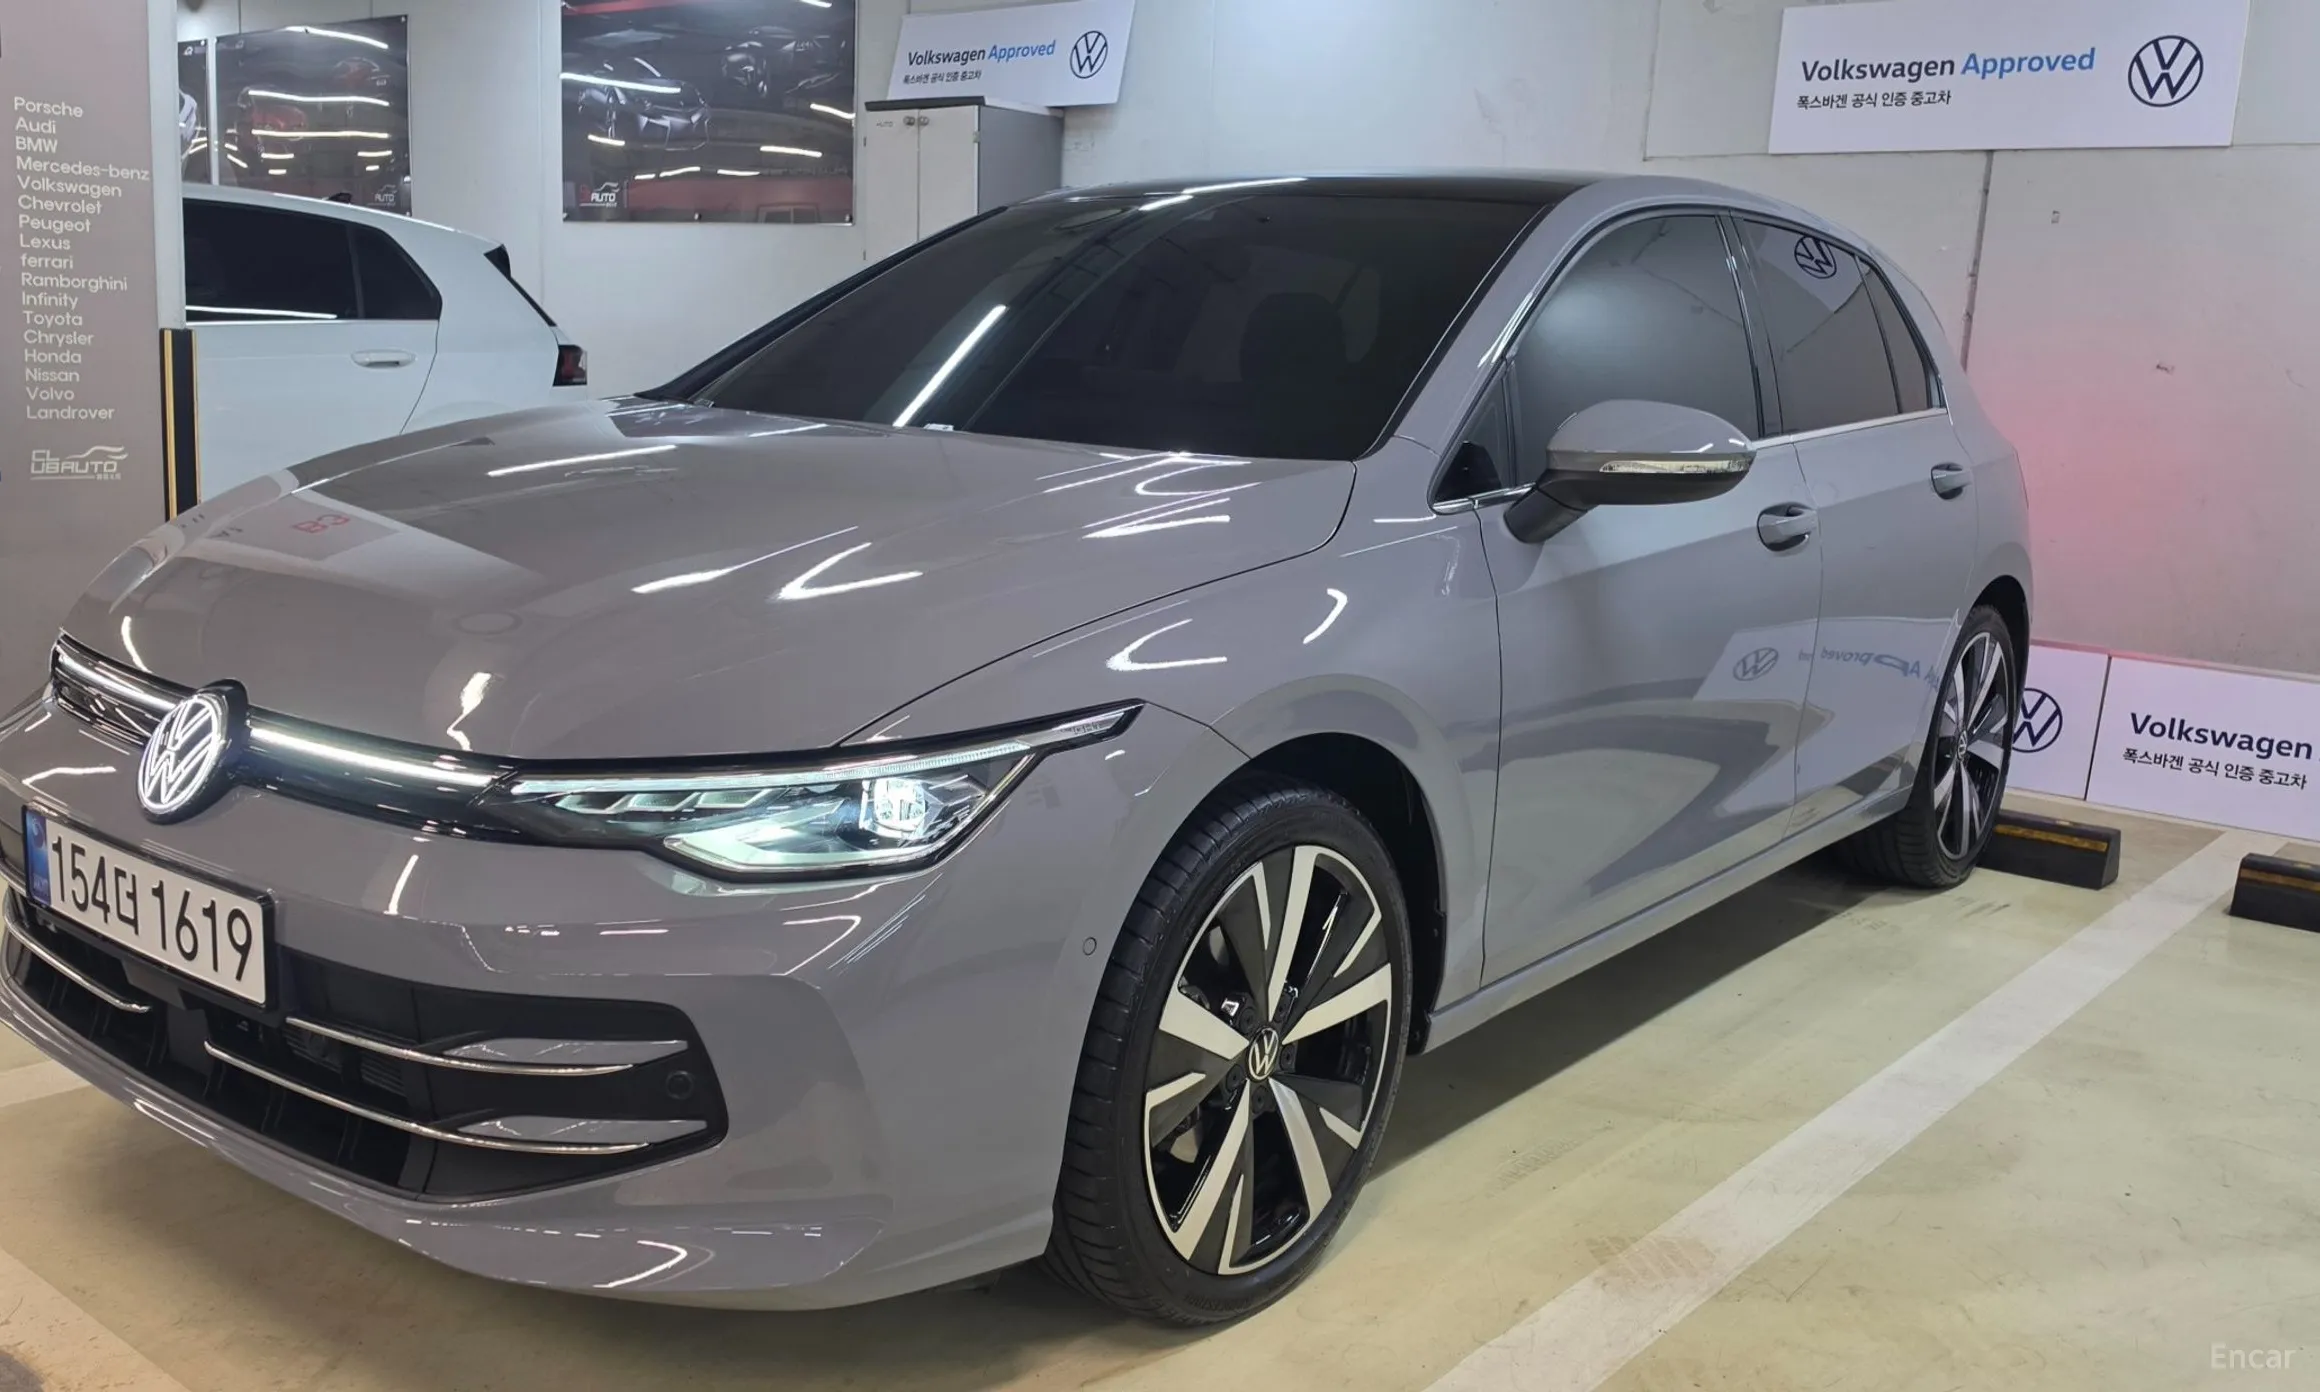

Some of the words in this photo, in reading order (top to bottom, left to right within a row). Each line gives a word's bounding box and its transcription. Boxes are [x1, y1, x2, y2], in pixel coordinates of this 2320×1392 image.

[908, 48, 986, 66] Volkswagen
[987, 40, 1056, 63] Approved
[1801, 55, 1955, 83] Volkswagen
[1961, 47, 2096, 79] Approved
[14, 96, 83, 118] Porsche
[1797, 94, 1848, 109] 폭스바겐
[1852, 92, 1878, 108] 공식
[1881, 91, 1907, 107] 인증
[1910, 89, 1952, 106] 중고차
[15, 117, 56, 134] Audi
[15, 136, 58, 153] BMW
[16, 155, 150, 181] Mercedes-benz
[17, 175, 122, 198] Volkswagen
[18, 194, 102, 214] Chevrolet
[19, 214, 91, 234] Peugeot
[20, 233, 71, 250] Lexus
[20, 253, 74, 269] ferrari
[21, 272, 128, 293] Ramborghini
[22, 291, 79, 310] Infinity
[23, 310, 83, 328] Toyota
[23, 329, 95, 347] Chrysler
[24, 349, 82, 364] Honda
[25, 367, 80, 382] Nissan
[26, 387, 75, 400] Volvo
[26, 405, 115, 419] Landrover
[2130, 712, 2312, 760] Volkswagen
[2122, 747, 2184, 771] 폭스바겐
[2188, 757, 2220, 777] 공식
[2224, 761, 2255, 782] 인증
[2258, 767, 2308, 790] 중고차
[52, 836, 139, 936] 154더
[151, 880, 252, 981] 1619
